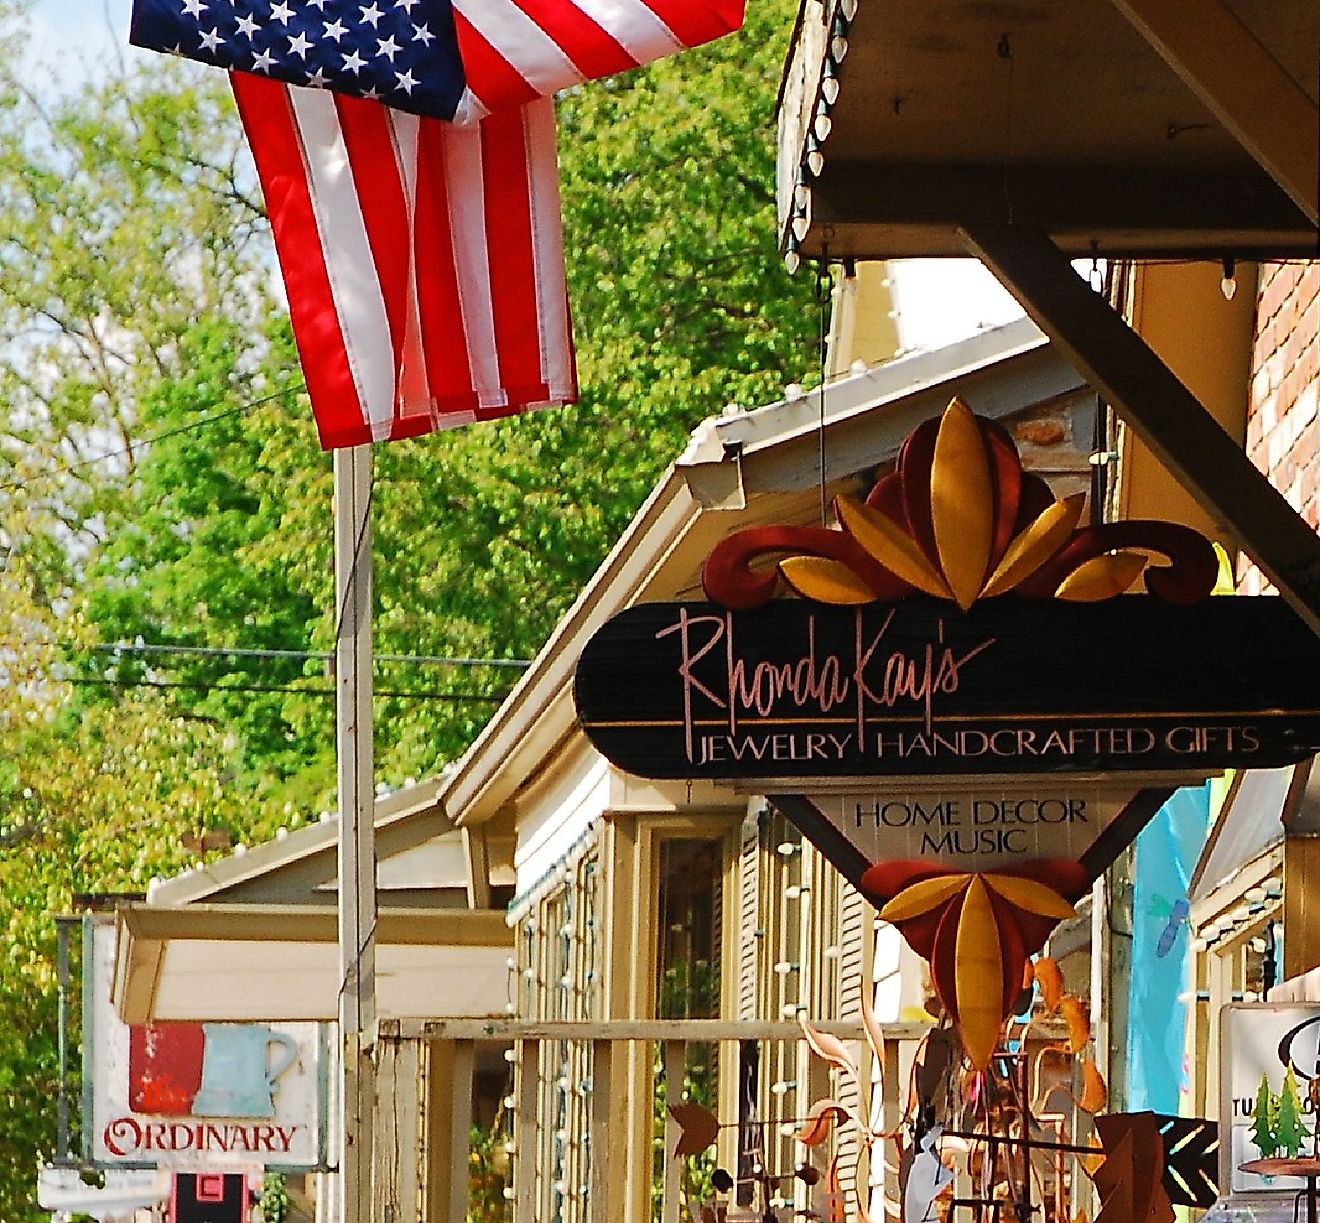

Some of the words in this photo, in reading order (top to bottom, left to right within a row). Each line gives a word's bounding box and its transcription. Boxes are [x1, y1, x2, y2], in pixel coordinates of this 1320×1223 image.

[655, 607, 849, 764] Rhonda
[698, 733, 852, 765] JEWELRY
[877, 730, 1156, 759] HANDCRAFTED
[1165, 726, 1260, 755] GIFTS
[855, 800, 960, 828] HOME
[971, 799, 1089, 826] DECOR
[919, 829, 1028, 856] MUSIC
[103, 1117, 298, 1156] ORDINARY
